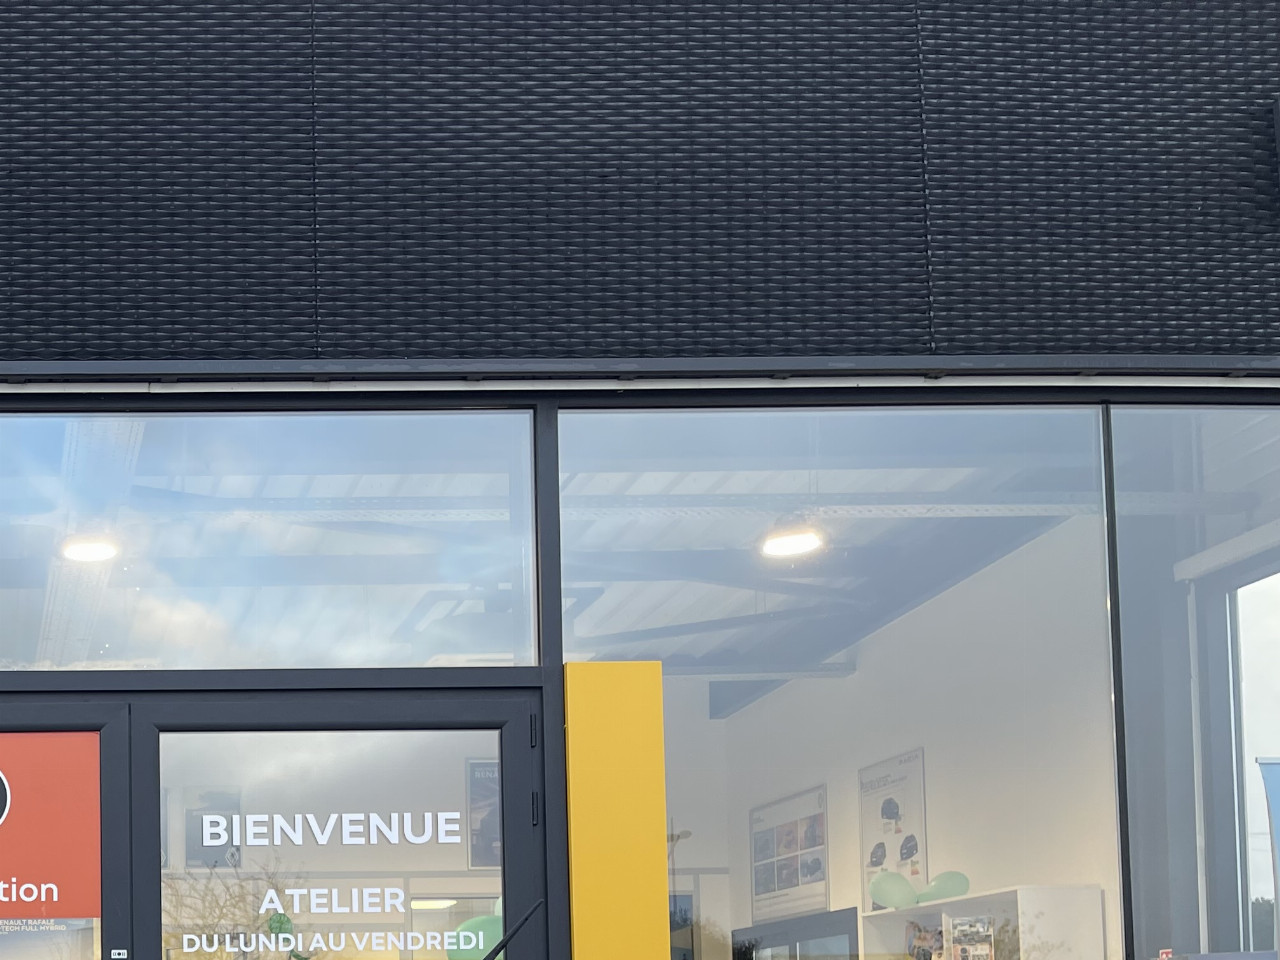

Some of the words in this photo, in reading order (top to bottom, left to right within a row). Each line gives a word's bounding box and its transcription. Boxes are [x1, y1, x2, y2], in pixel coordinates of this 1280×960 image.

[201, 811, 461, 847] BIENVENUE
[258, 887, 406, 914] ATELIER
[182, 933, 219, 953] DU
[224, 933, 303, 953] LUNDI
[308, 933, 346, 952] AU
[351, 931, 484, 951] VENDREDI
